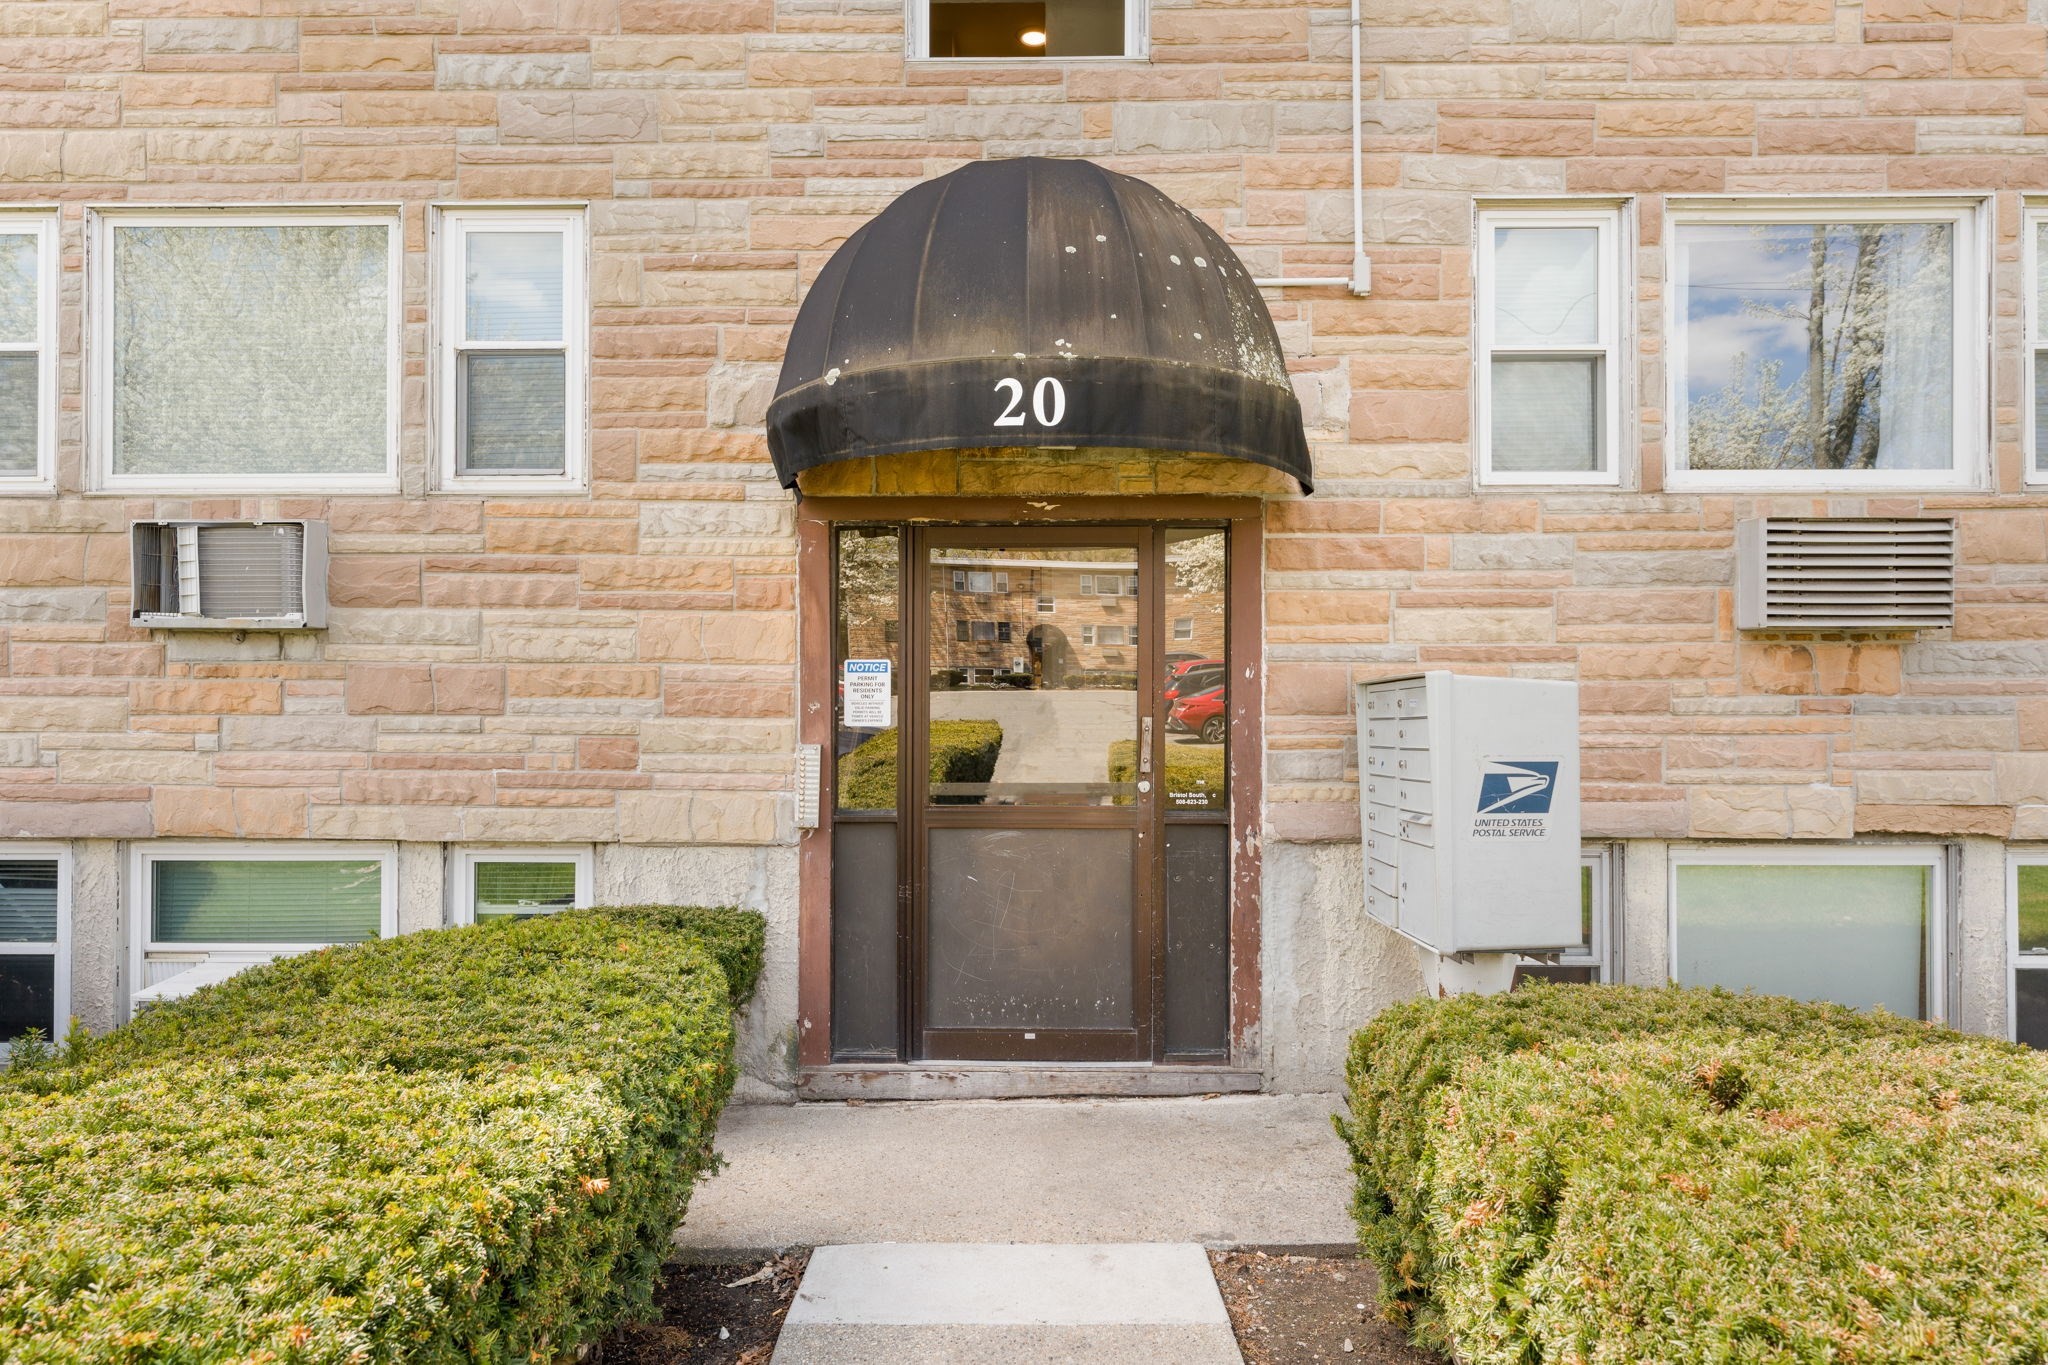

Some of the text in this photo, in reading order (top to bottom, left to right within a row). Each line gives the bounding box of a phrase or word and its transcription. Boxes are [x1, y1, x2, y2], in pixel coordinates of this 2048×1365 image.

[993, 376, 1066, 427] 20
[848, 663, 887, 672] NOTICE
[1474, 818, 1544, 827] UNITED STATES
[1472, 828, 1546, 837] POSTAL SERVICE
